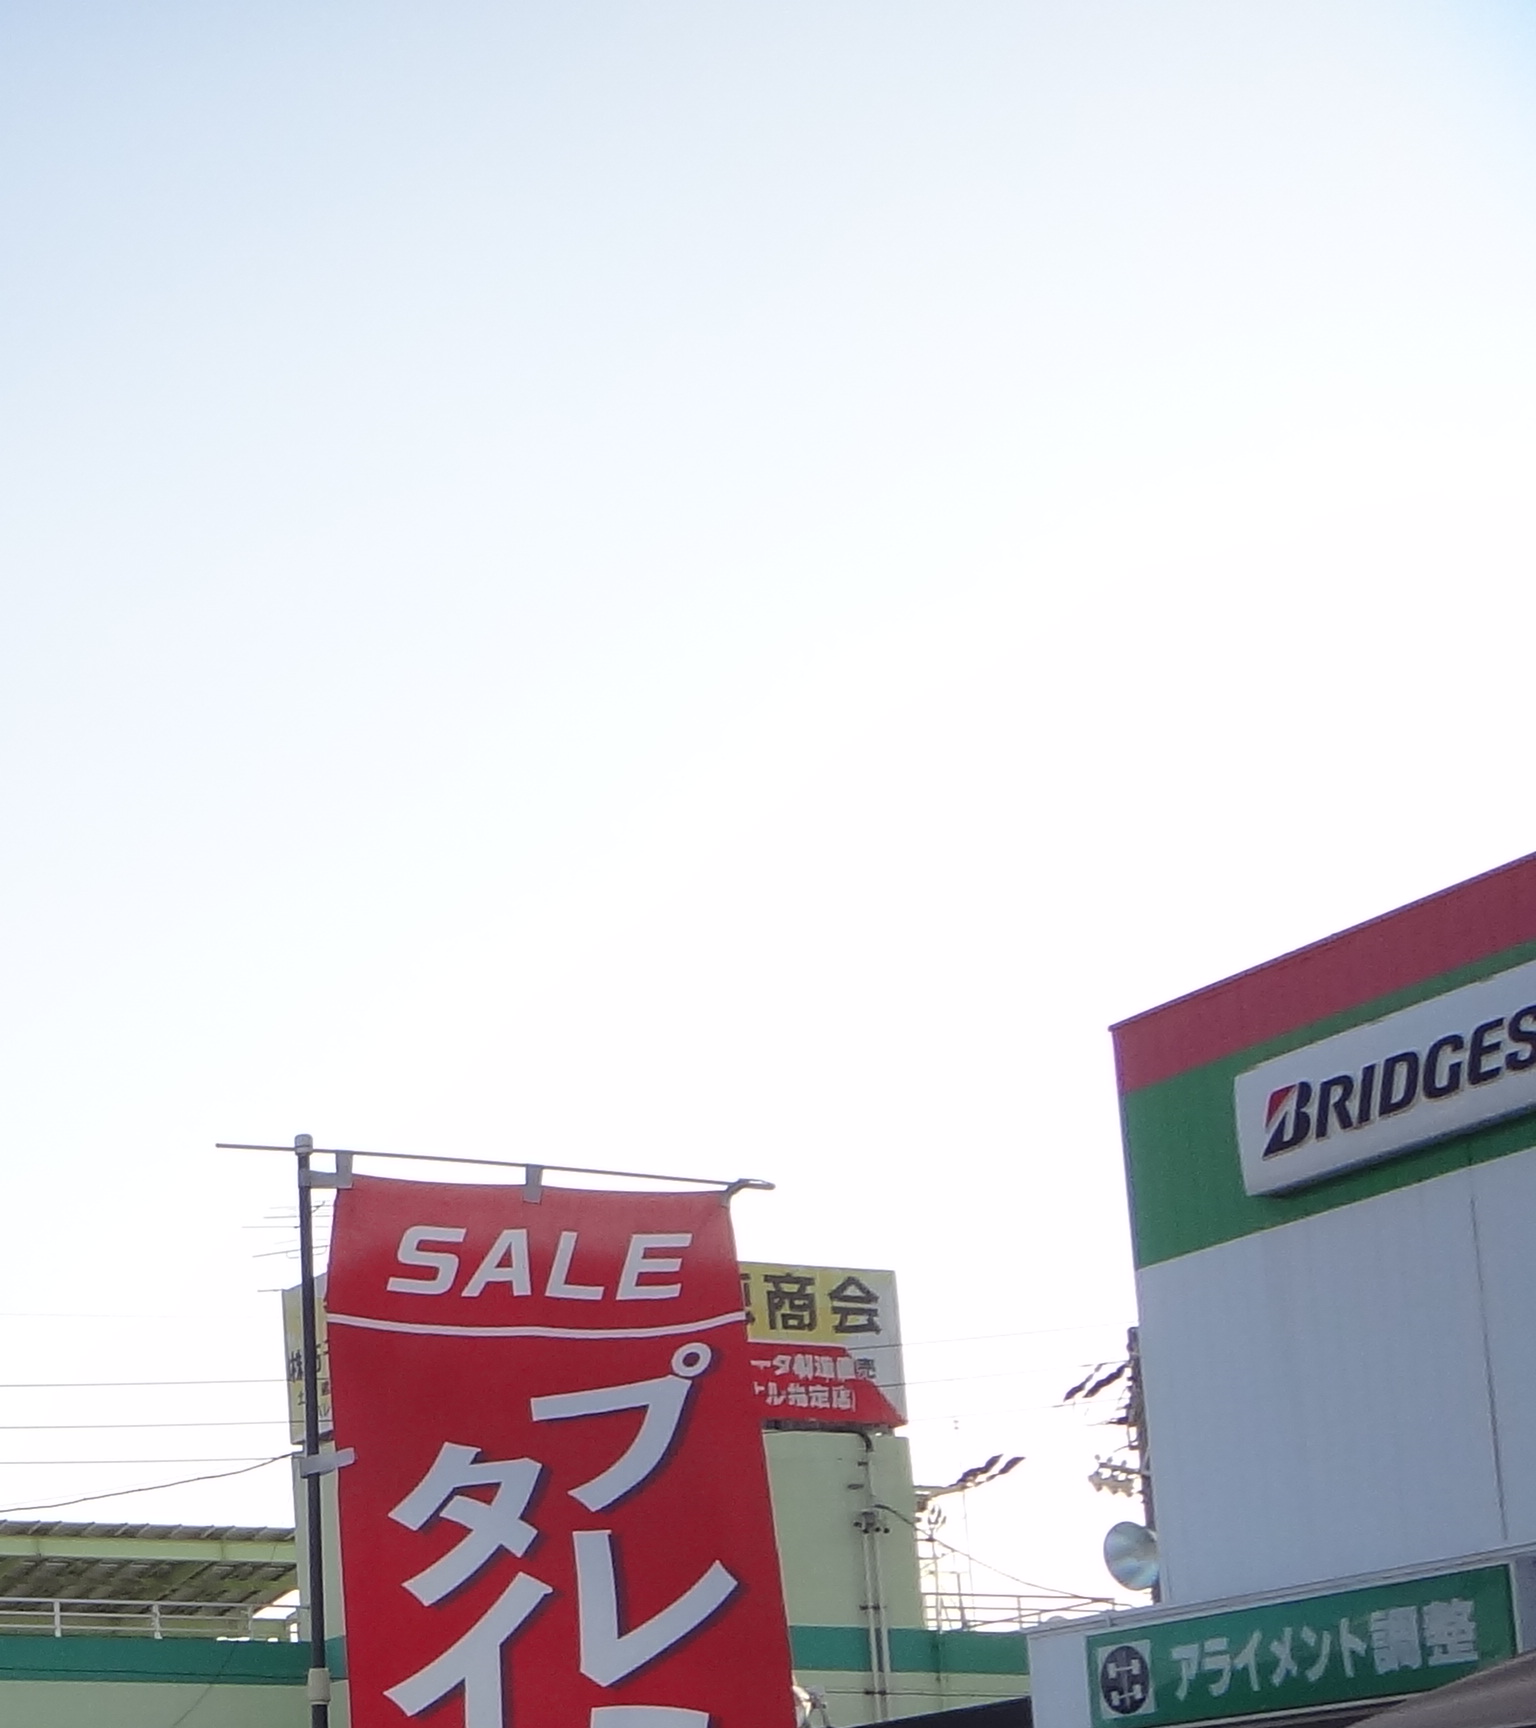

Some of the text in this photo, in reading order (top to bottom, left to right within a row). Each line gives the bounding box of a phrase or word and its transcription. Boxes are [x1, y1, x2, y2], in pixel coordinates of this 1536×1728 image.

[387, 1225, 693, 1300] SALE
[741, 1272, 883, 1335] 商会
[1170, 1598, 1479, 1701] アライメント調整
